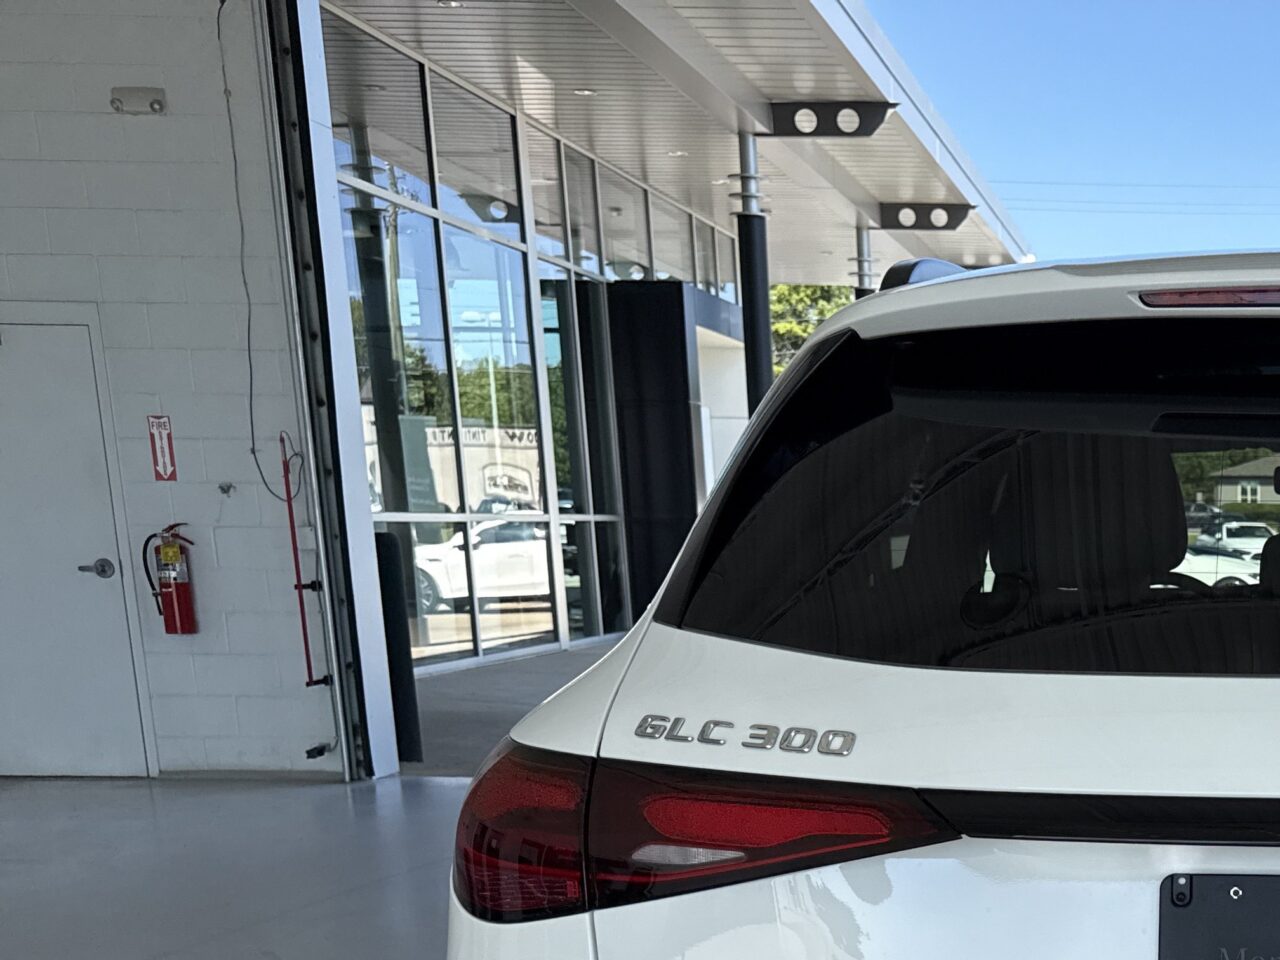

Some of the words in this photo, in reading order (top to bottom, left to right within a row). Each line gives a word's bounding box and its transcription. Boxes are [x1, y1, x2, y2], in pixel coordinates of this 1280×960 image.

[150, 420, 169, 431] FIRE
[634, 714, 735, 746] GLC
[740, 723, 857, 757] 300
